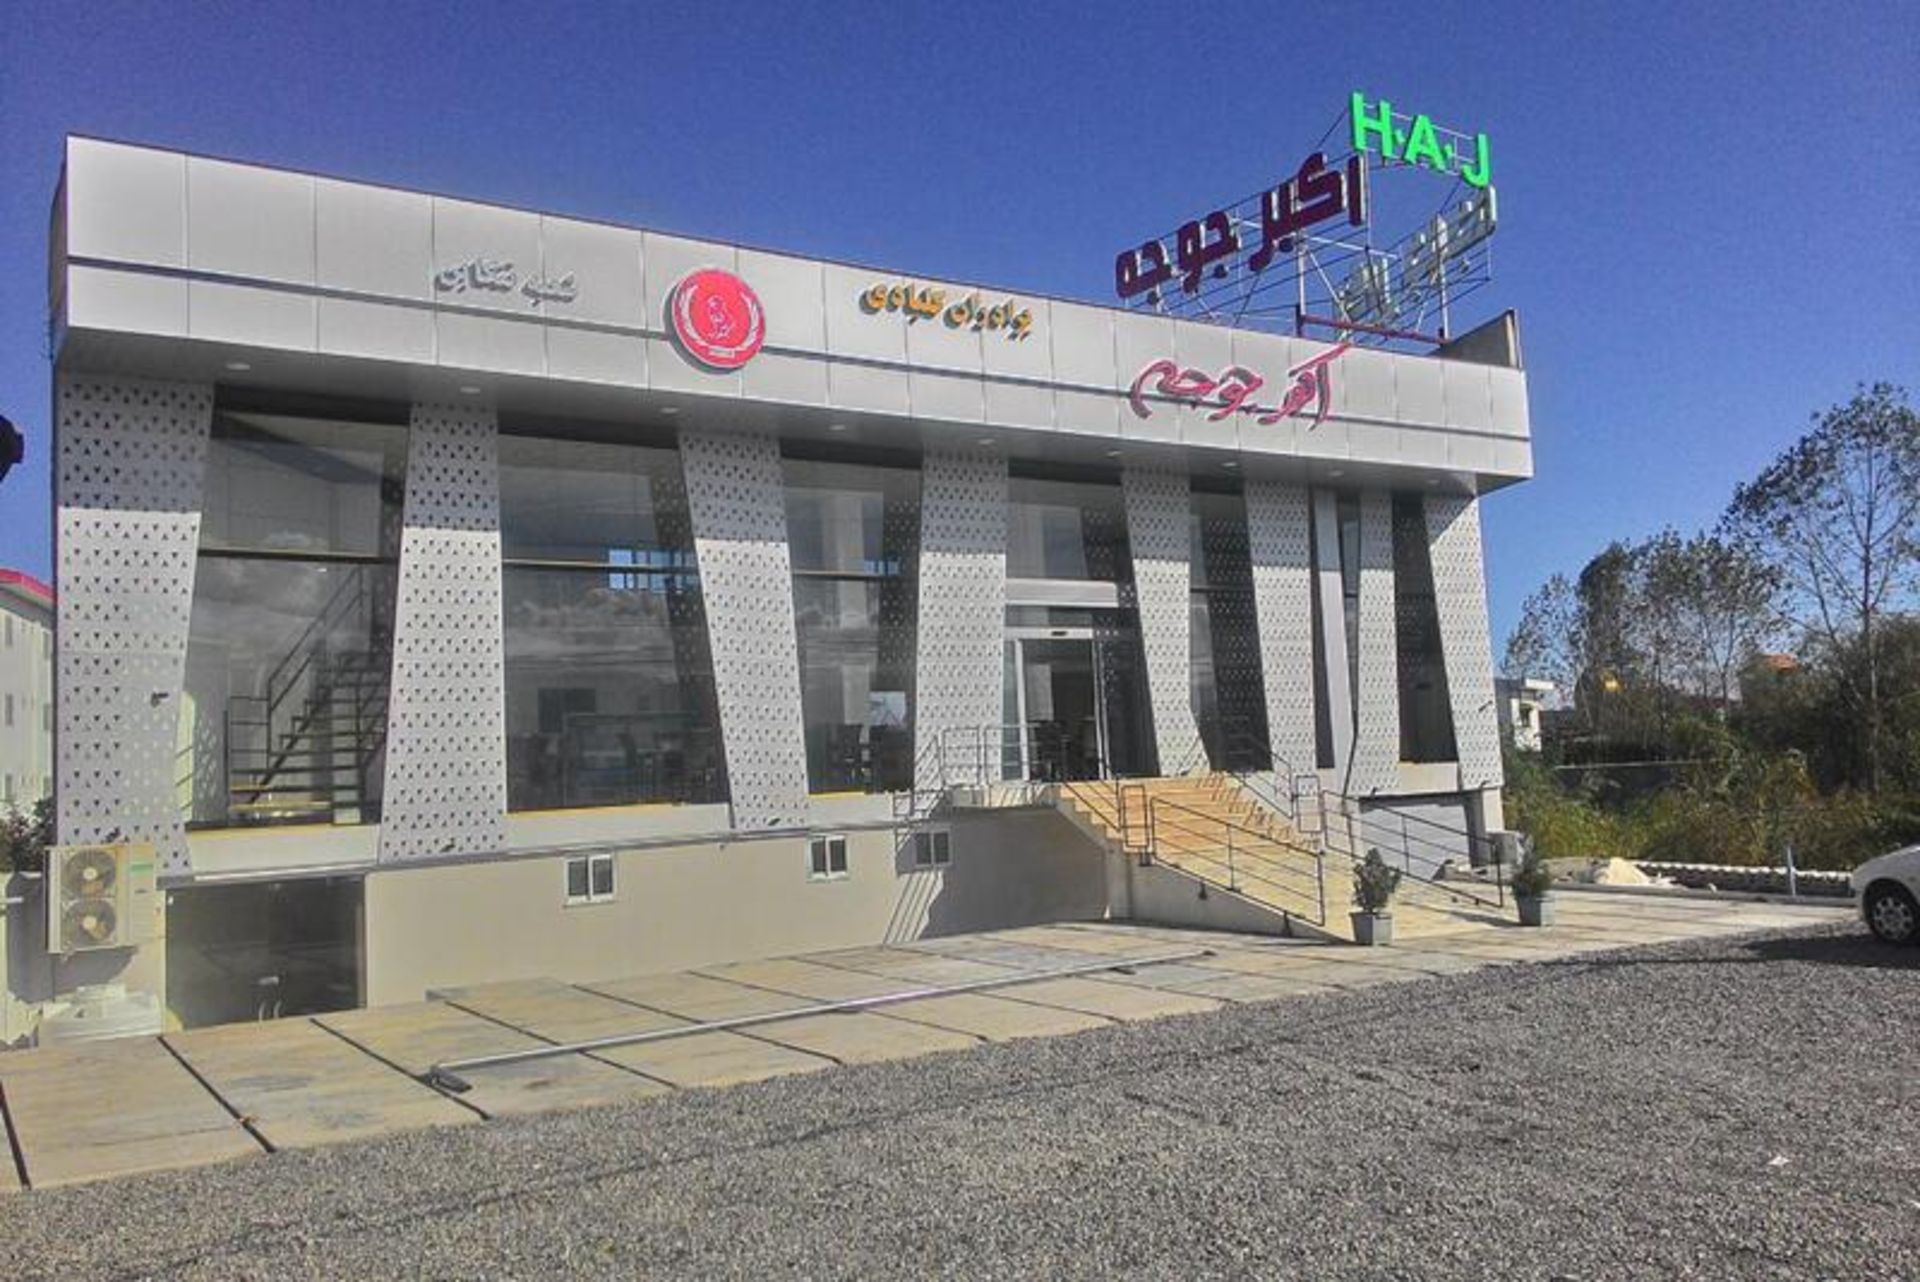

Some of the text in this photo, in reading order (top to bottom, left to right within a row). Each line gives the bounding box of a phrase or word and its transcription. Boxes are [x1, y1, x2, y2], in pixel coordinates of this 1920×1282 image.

[1115, 209, 1242, 304] جوجه
[1249, 152, 1366, 272] اکبر
[943, 297, 1033, 341] برادران
